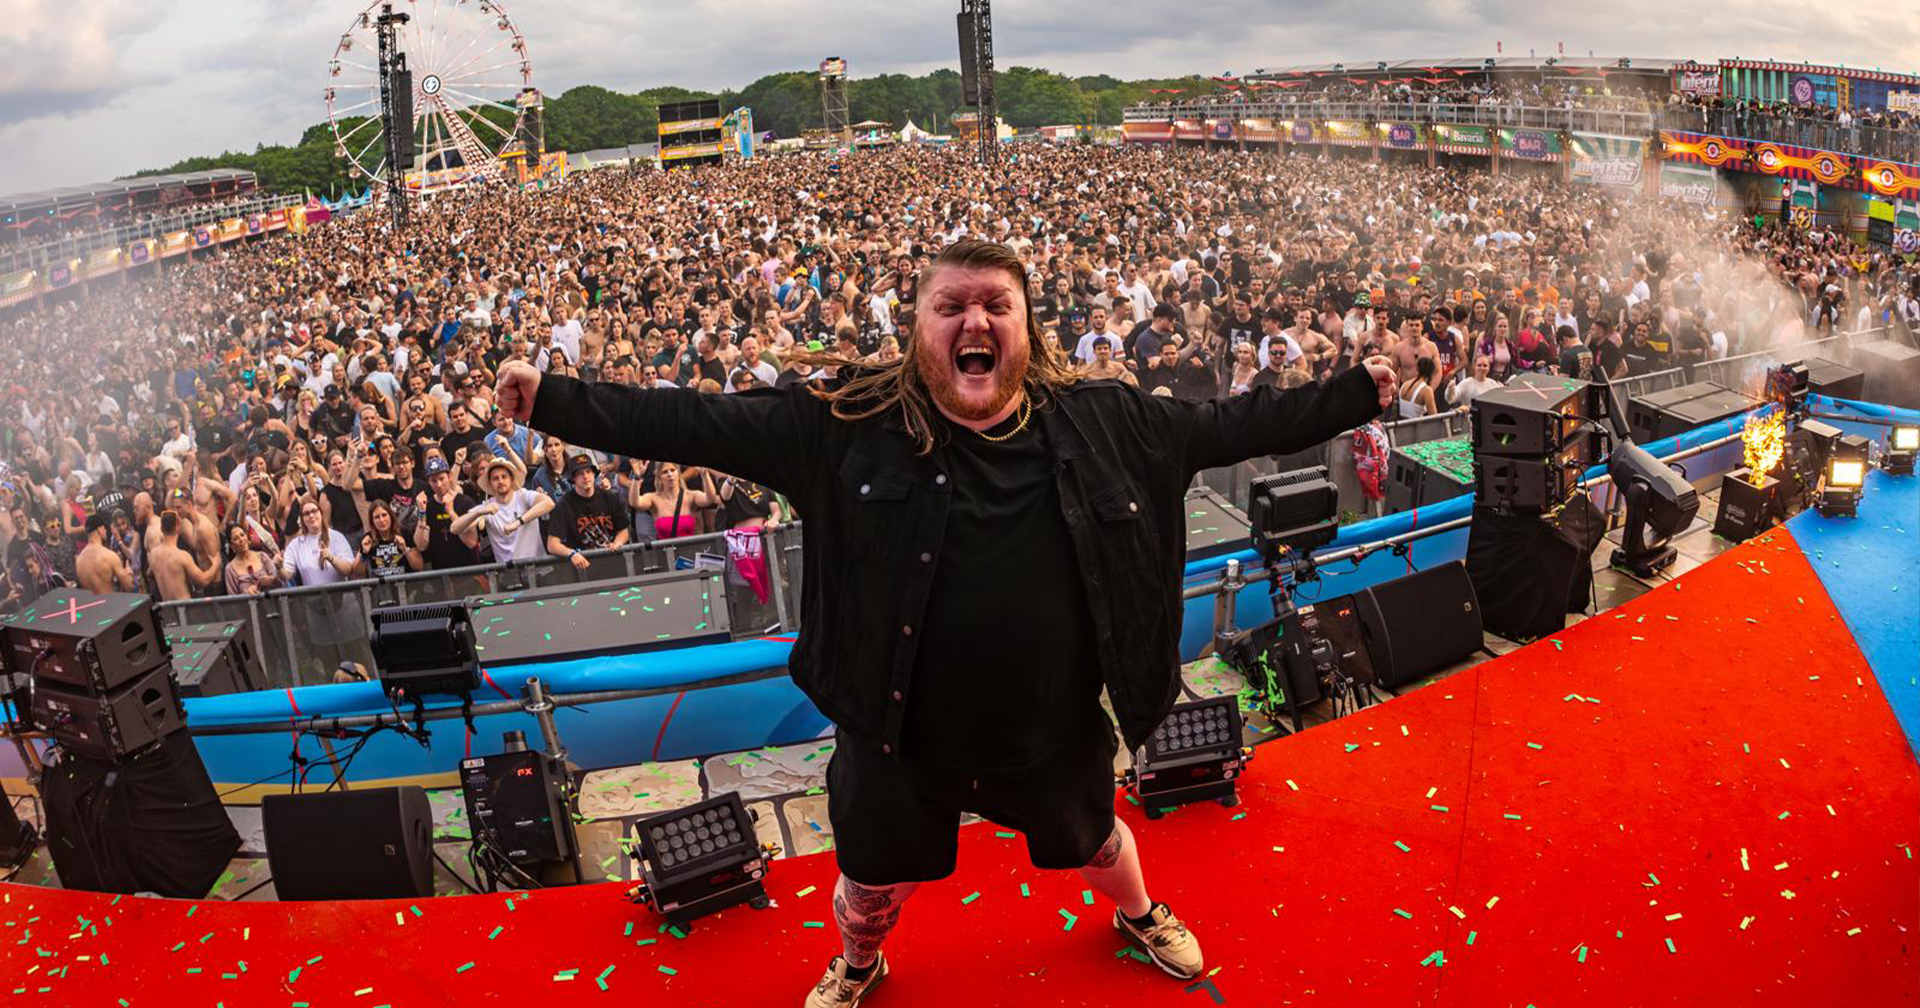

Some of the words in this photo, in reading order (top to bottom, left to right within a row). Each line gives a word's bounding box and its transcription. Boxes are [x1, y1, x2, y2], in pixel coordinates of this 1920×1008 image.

[1393, 129, 1411, 141] BAR
[1453, 130, 1484, 144] Bavaria
[1519, 138, 1542, 152] BAR
